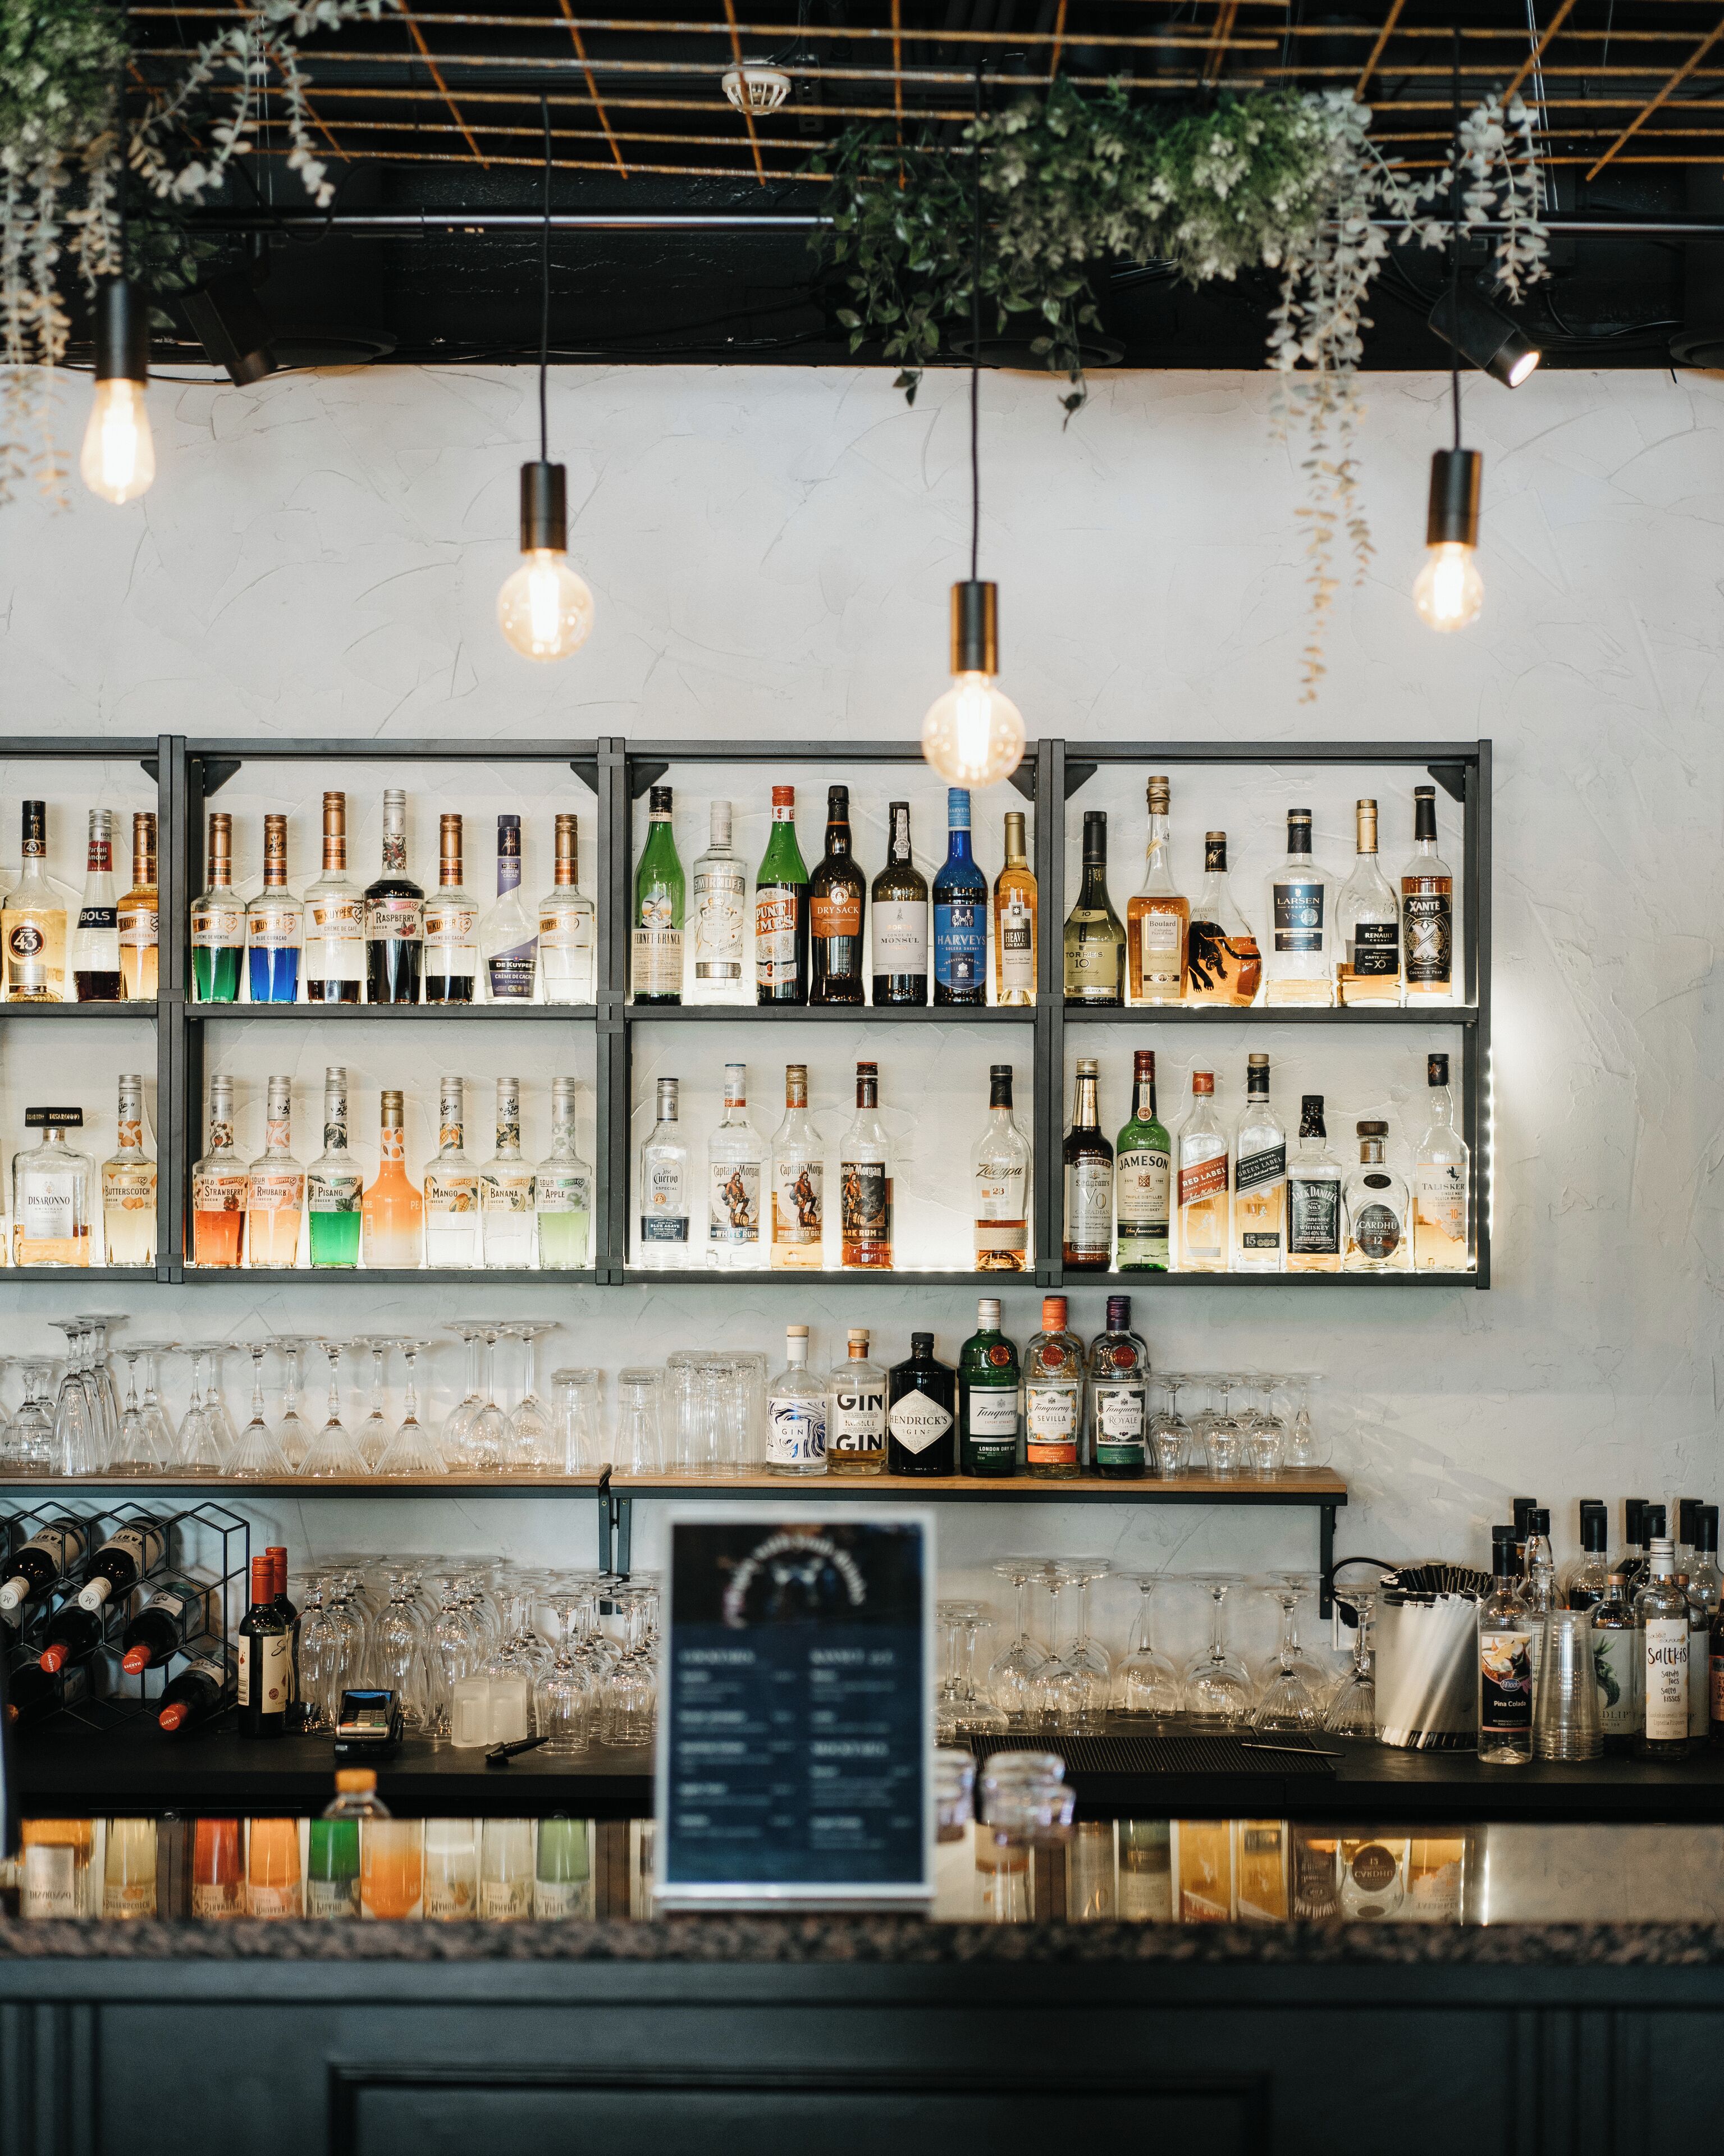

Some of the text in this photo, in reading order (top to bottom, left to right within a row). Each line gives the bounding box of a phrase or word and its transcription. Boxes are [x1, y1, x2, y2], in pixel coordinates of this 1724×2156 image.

[26, 842, 37, 852] 43
[694, 878, 742, 890] SMIRNOFF
[757, 902, 786, 921] PUNT
[1409, 901, 1440, 912] XANTÉ
[80, 911, 110, 920] BOLS
[324, 908, 351, 920] KUYPER
[376, 912, 414, 923] RASPBERRY
[123, 917, 145, 930] KUYPER
[198, 919, 221, 930] KUYPER
[257, 919, 280, 930] KUYPER
[432, 919, 456, 931] KUYPER
[542, 920, 561, 931] KUYPER
[761, 915, 795, 932] MES
[13, 933, 38, 949] 43
[634, 934, 680, 944] FERNET-BRANCA
[938, 934, 985, 945] HARVEYS
[1074, 958, 1090, 968] 10
[1374, 960, 1386, 969] XO
[1077, 1159, 1110, 1168] IMPORTED
[1119, 1155, 1168, 1171] JAMESON
[1237, 1157, 1283, 1177] GREEN LABEL
[1241, 1160, 1259, 1169] JOHNNIE
[714, 1165, 759, 1177] Captain Morgan
[780, 1164, 804, 1176] Captain
[854, 1164, 879, 1177] Morgan
[976, 1163, 1023, 1179] Zacapa
[653, 1174, 678, 1184] Cuervo
[1182, 1167, 1226, 1187] RED LABEL
[105, 1186, 150, 1195] BUTTERSCOTCH
[205, 1186, 244, 1196] STRAWBERRY
[257, 1186, 286, 1196] RHUBARB
[318, 1187, 343, 1196] PISANG
[433, 1187, 458, 1198] MANGO
[491, 1188, 518, 1198] BANANA
[546, 1189, 565, 1198] APPLE
[993, 1187, 1005, 1196] 23
[1292, 1186, 1338, 1203] JACK DANIEL'S
[28, 1196, 70, 1205] DISARONNO
[1081, 1188, 1106, 1209] VO
[1450, 1209, 1458, 1219] 10
[1359, 1221, 1398, 1230] CARDHU
[1246, 1236, 1256, 1245] 15
[837, 1395, 882, 1411] GIN
[1035, 1403, 1070, 1413] Tanqueray
[977, 1407, 1017, 1419] Tanqueray
[1106, 1405, 1141, 1414] Tanqueray
[890, 1415, 948, 1425] HENDRICK'S
[1108, 1415, 1137, 1425] ROYALE
[836, 1433, 882, 1451] GIN
